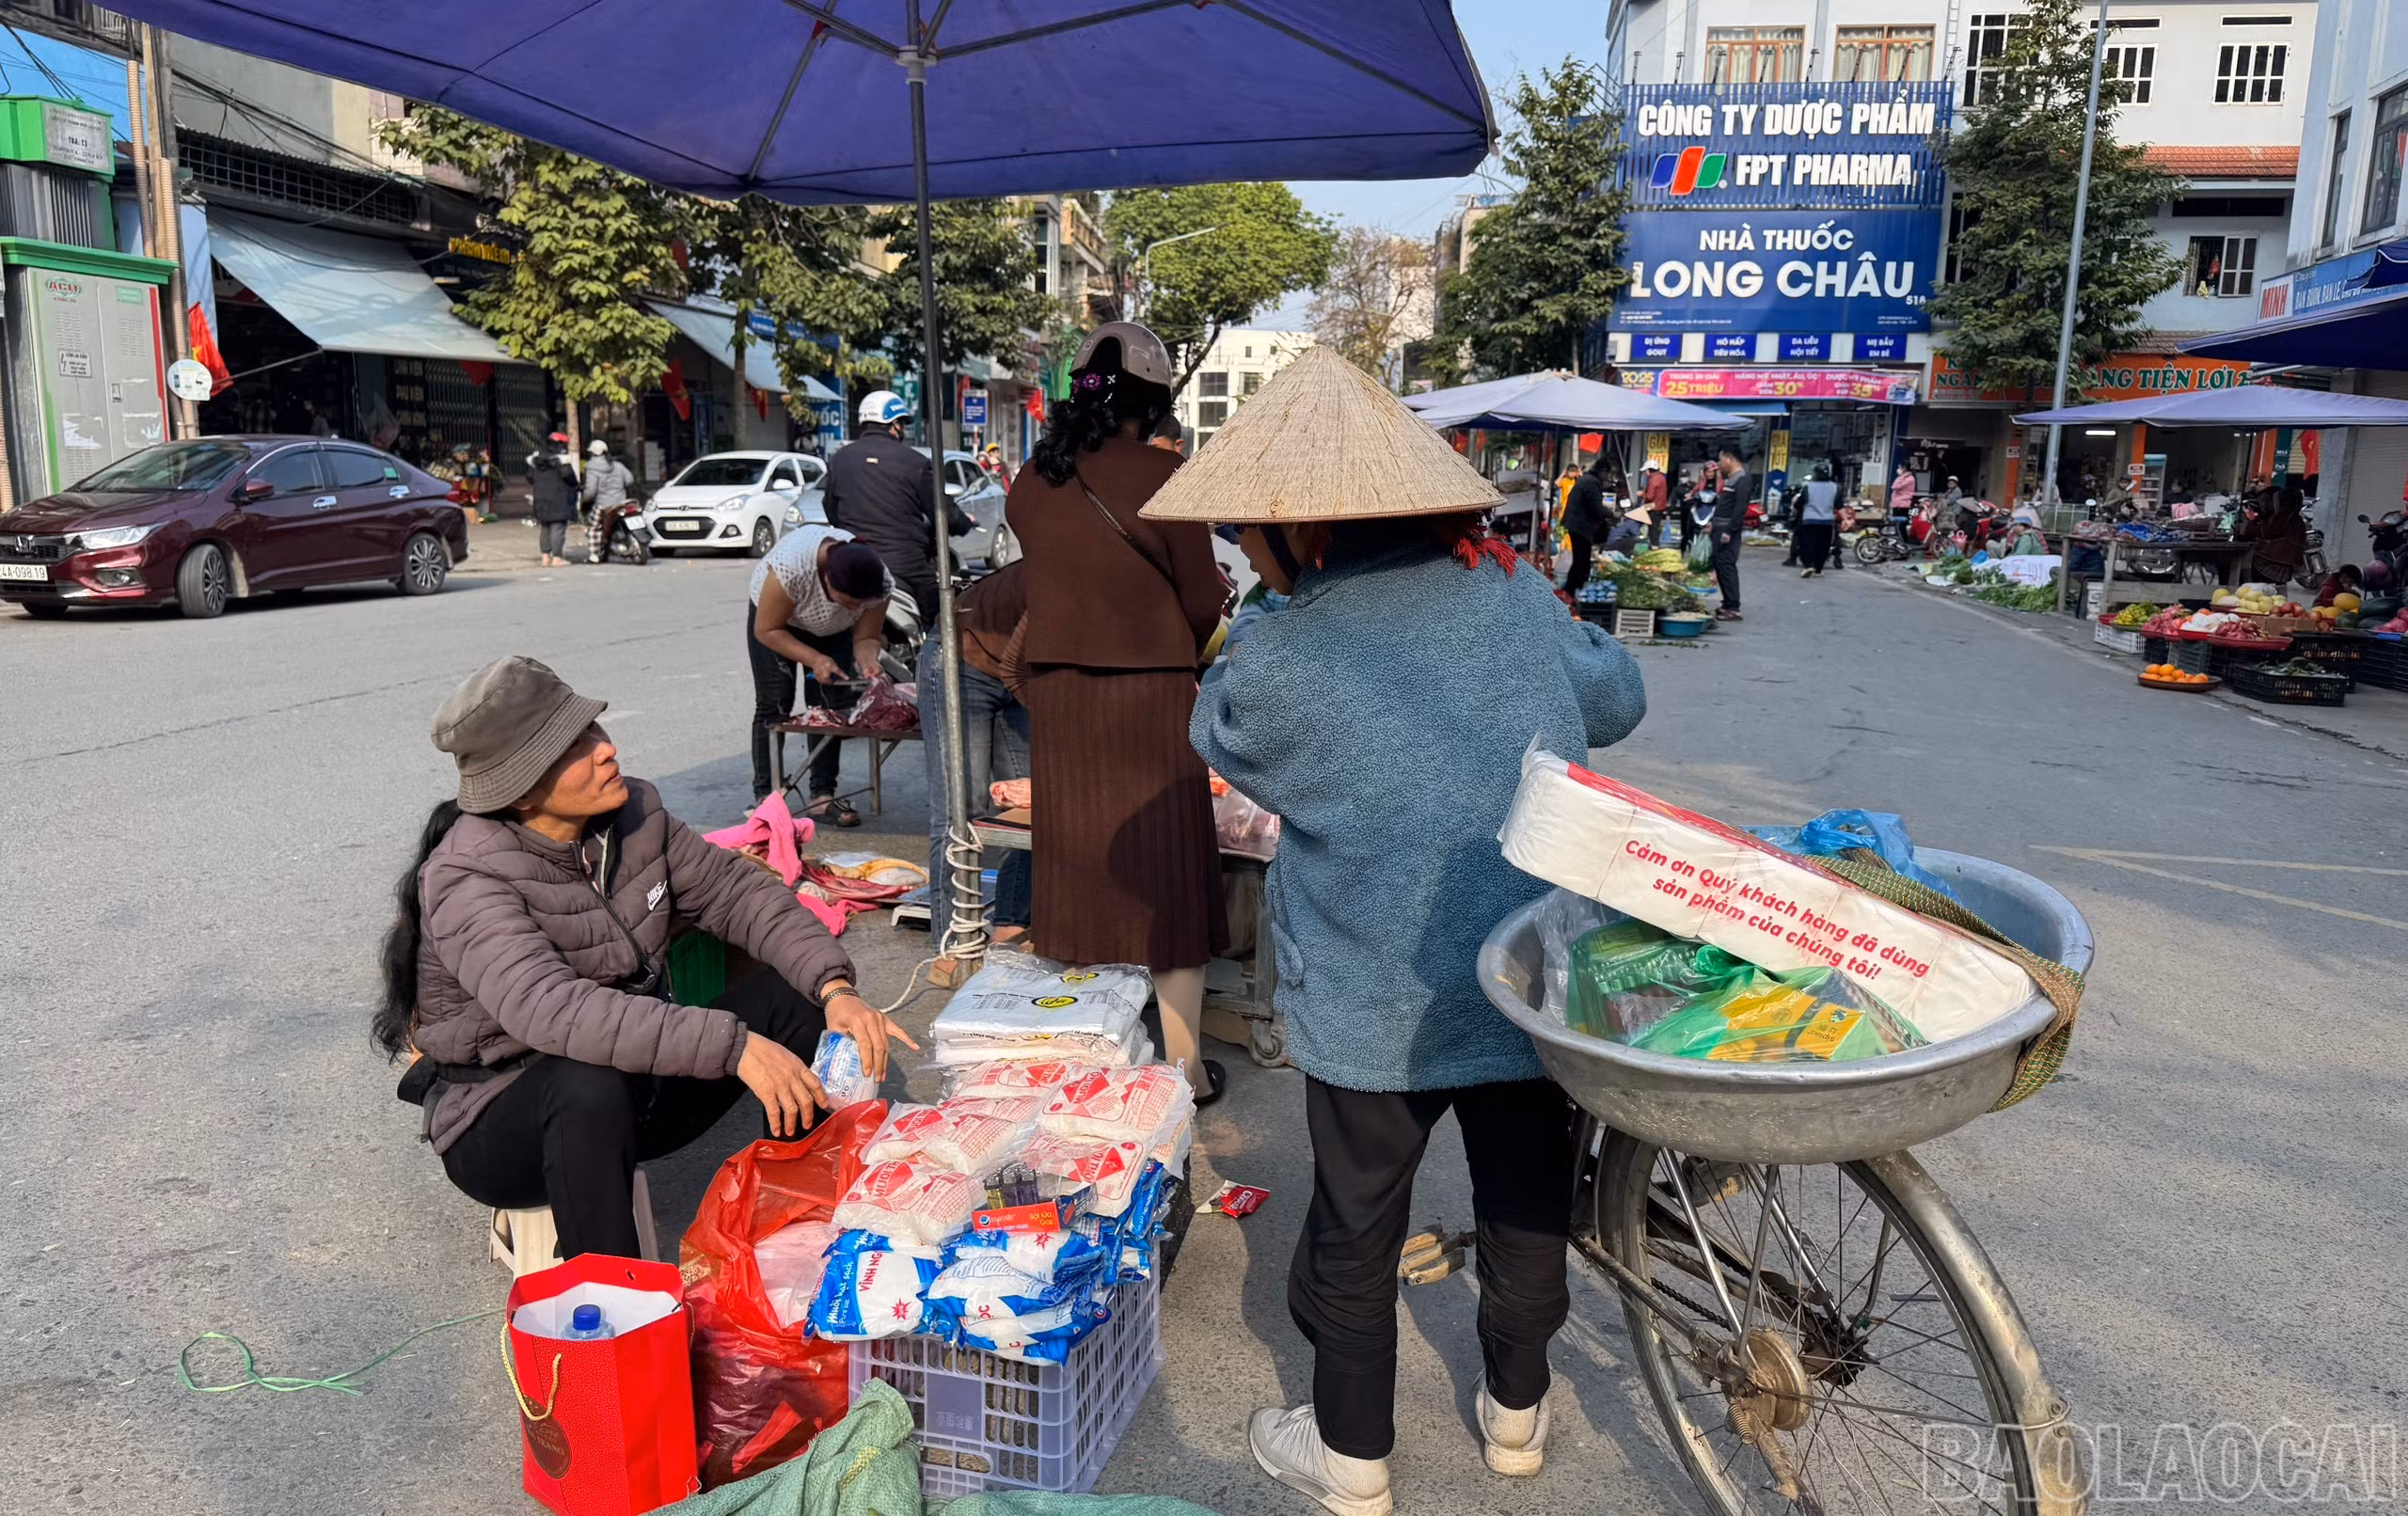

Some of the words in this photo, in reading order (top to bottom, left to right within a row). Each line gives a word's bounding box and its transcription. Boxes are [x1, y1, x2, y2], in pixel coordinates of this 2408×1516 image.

[1638, 100, 1713, 136] CÔNG
[1722, 104, 1759, 135] TY
[1764, 98, 1843, 140] DƯỢC
[1851, 88, 1935, 135] PHẨM
[1735, 154, 1786, 186] FPT
[1793, 153, 1912, 186] PHARMA
[1700, 223, 1754, 251] NHÀ
[1764, 220, 1854, 251] THUỐC
[1630, 261, 1764, 298] LONG
[1777, 251, 1914, 298] CHÂU
[1906, 295, 1926, 306] 518
[2259, 284, 2289, 319] MINH
[1666, 382, 1687, 395] 25
[2137, 363, 2193, 395] TIỆN
[2198, 364, 2236, 390] LỢI
[0, 566, 45, 578] 4A-098.19
[647, 882, 662, 903] NIKE
[1625, 840, 1668, 866] Cảm
[1671, 861, 1695, 877] ơn
[1699, 869, 1738, 894] Quý
[1738, 883, 1798, 918] khách
[1798, 908, 1849, 942] hàng
[1851, 933, 1878, 953] đã
[1879, 946, 1930, 978] dùng
[1653, 878, 1688, 899] sản
[1686, 892, 1746, 921] phẩm
[1748, 915, 1783, 938] của
[1785, 931, 1844, 967] chúng
[1846, 955, 1881, 980] tôi!
[859, 1268, 877, 1292] VĨNH
